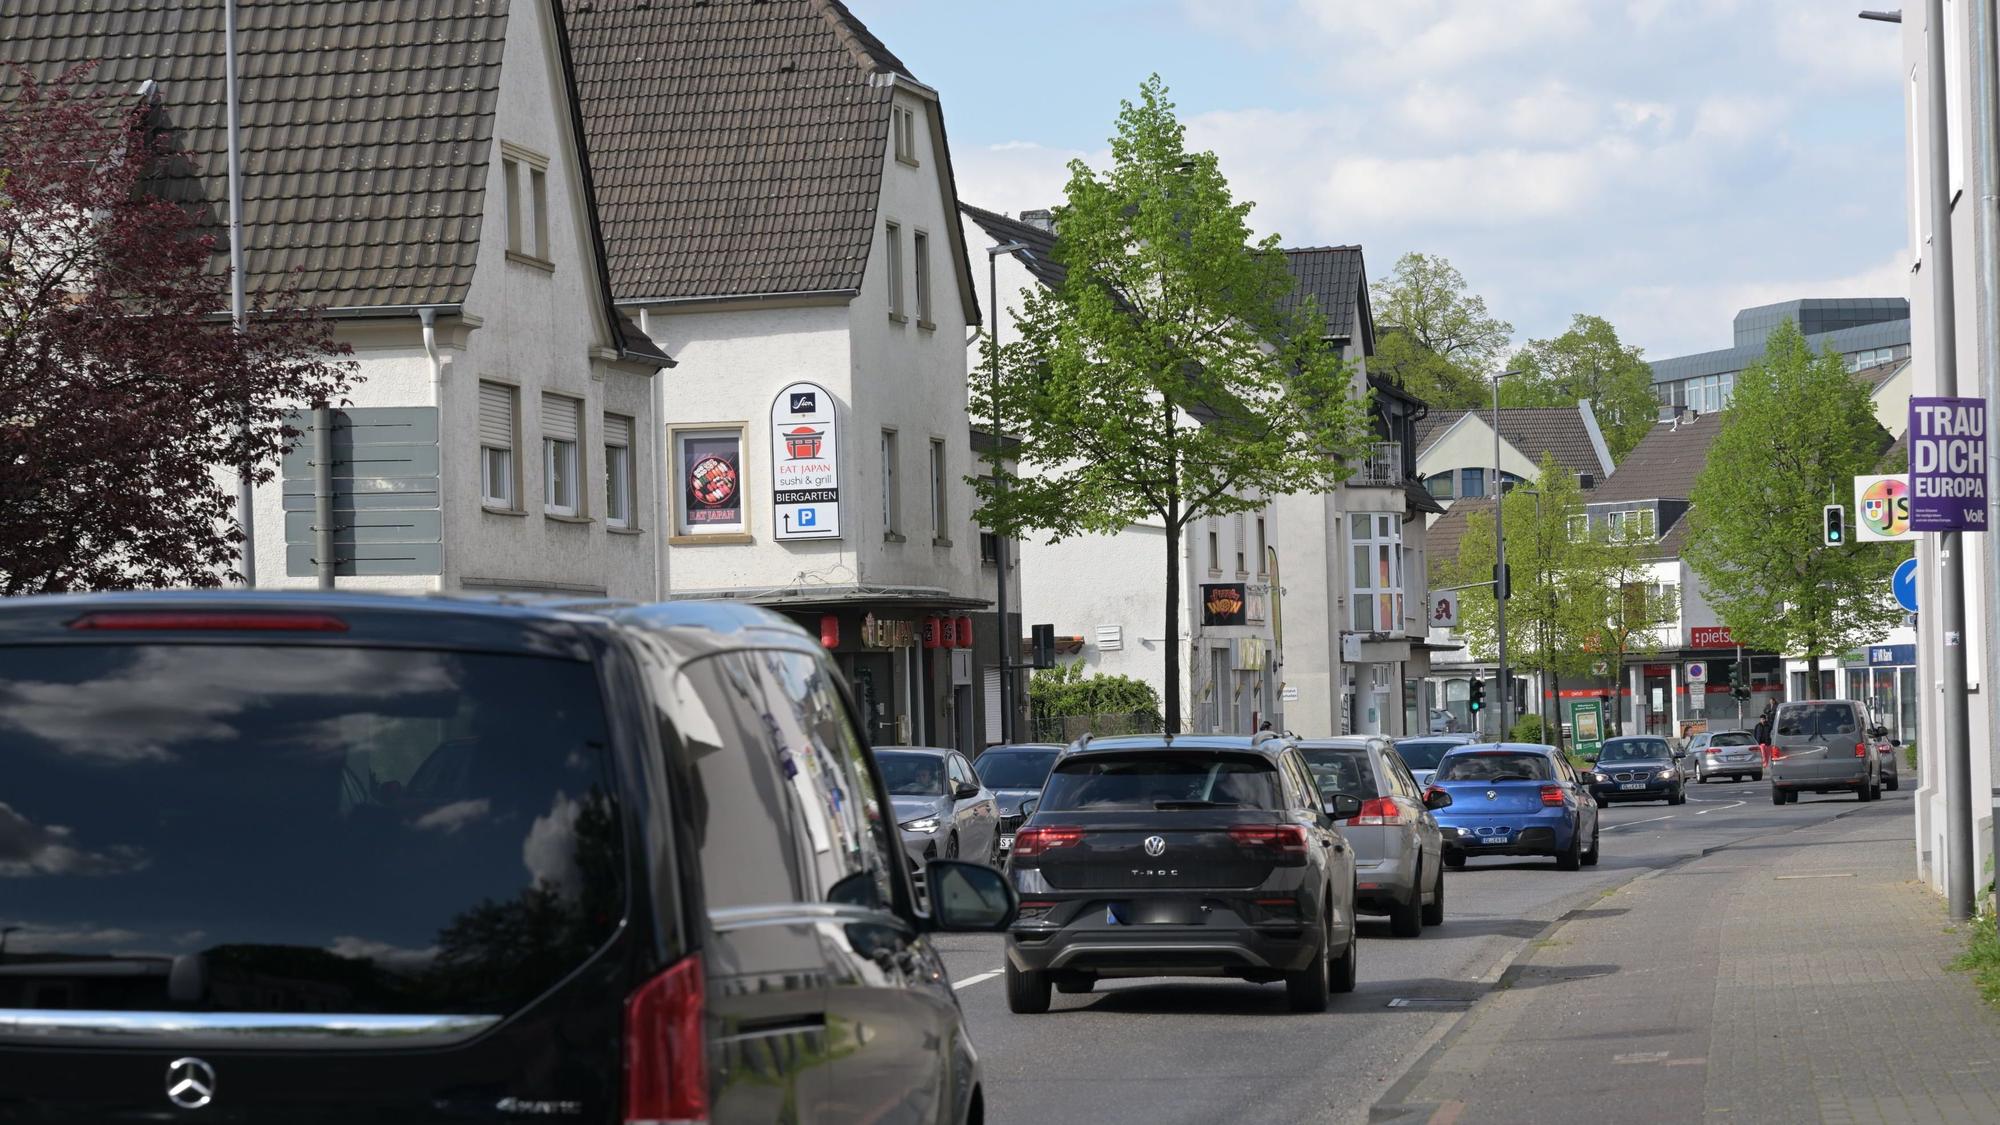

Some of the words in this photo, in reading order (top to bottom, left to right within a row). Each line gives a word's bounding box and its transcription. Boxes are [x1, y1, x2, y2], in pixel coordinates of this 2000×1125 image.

[1915, 406, 1983, 437] TRAU
[1915, 439, 1984, 474] DICH
[780, 465, 797, 474] EAT
[801, 463, 831, 475] JAPAN
[780, 476, 803, 486] sushi
[805, 476, 813, 485] &
[815, 474, 832, 487] grill
[1915, 477, 1984, 498] EUROPA
[776, 491, 837, 502] BIERGARTEN
[1963, 508, 1985, 523] Volt
